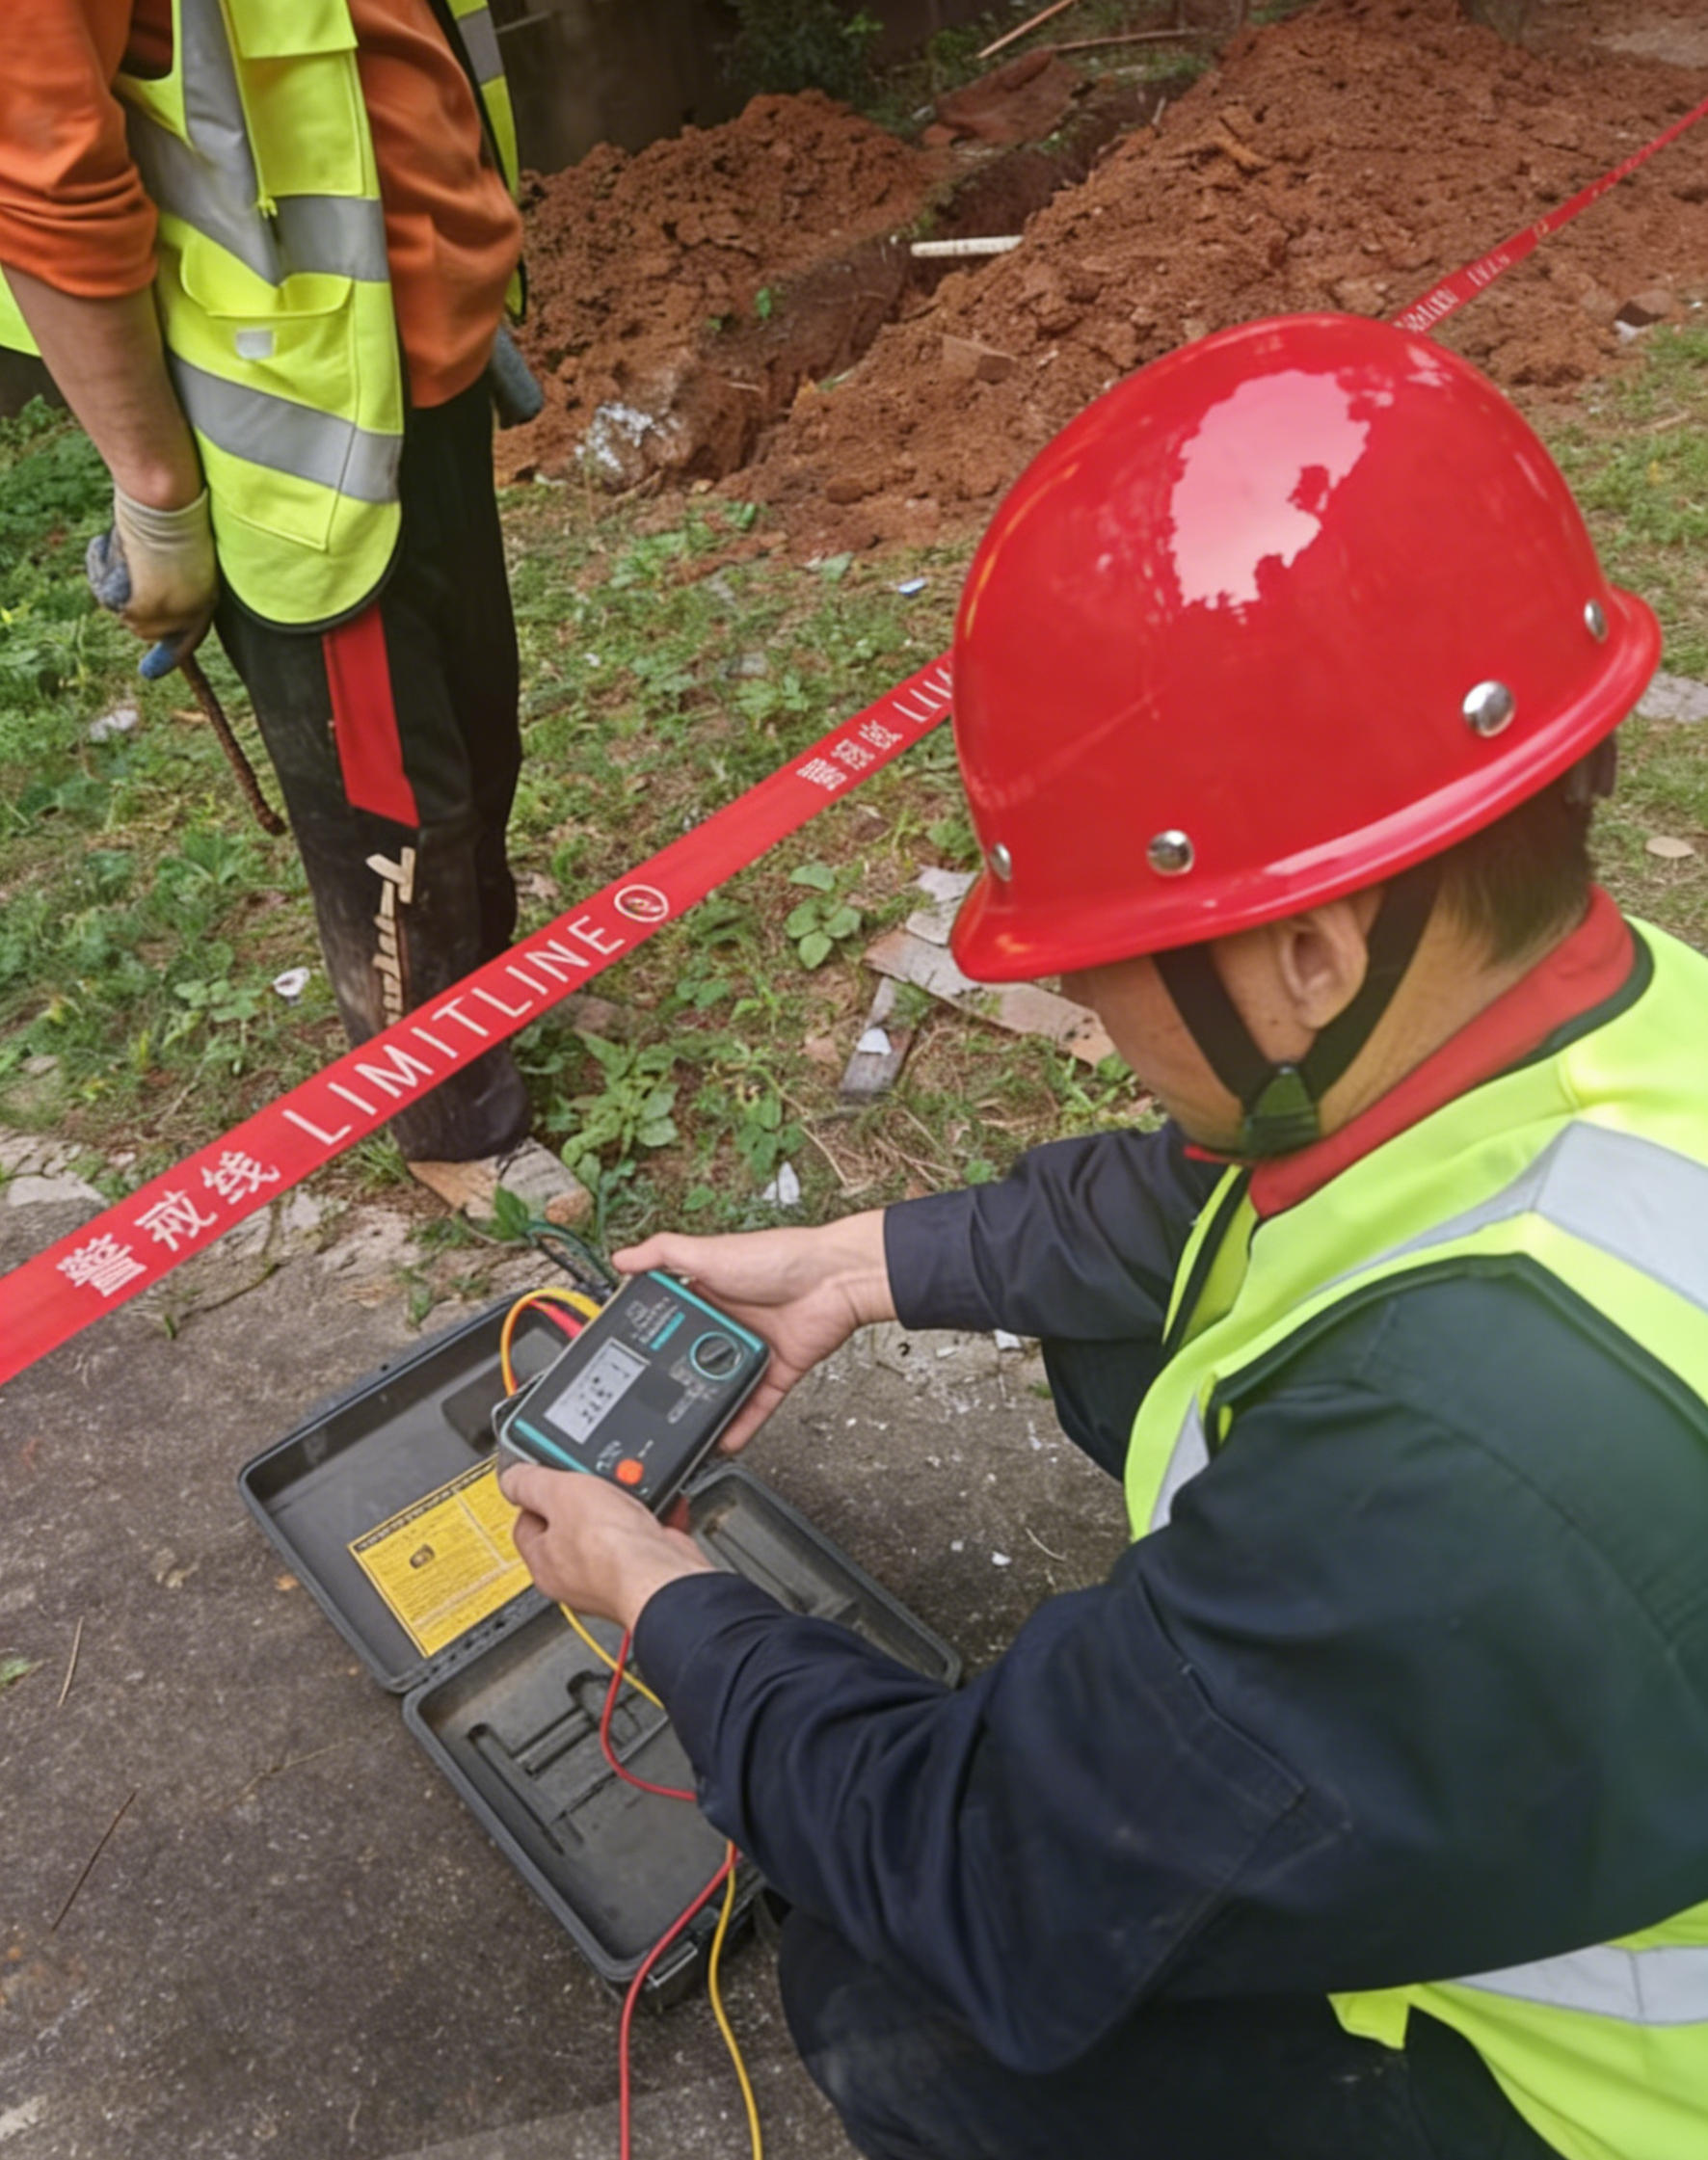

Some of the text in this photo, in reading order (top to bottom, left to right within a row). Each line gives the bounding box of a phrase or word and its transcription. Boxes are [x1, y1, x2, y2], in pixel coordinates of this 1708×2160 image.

[56, 1150, 281, 1297] 警戒线
[281, 916, 625, 1146] LIMITLINE
